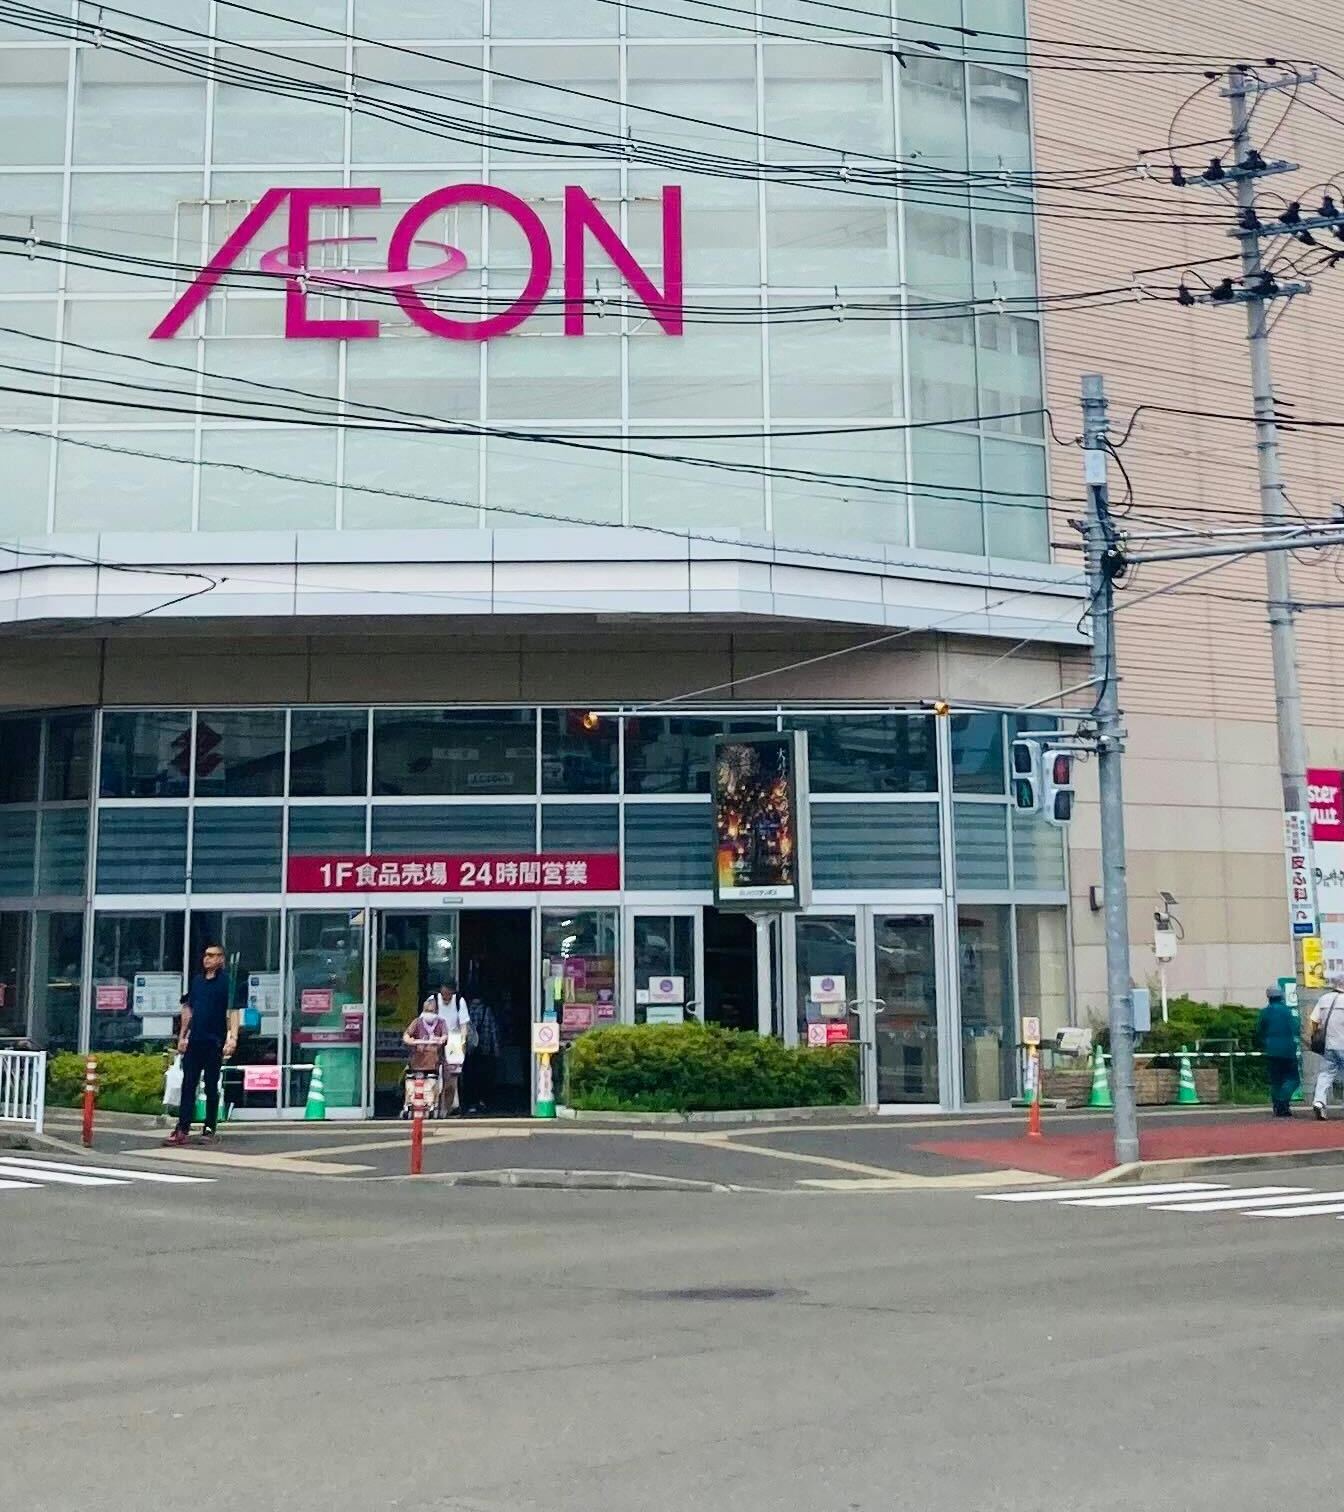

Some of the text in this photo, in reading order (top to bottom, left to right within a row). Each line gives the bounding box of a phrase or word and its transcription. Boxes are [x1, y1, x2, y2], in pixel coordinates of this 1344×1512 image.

[320, 862, 587, 886] 1F食品売場 24時間営業
